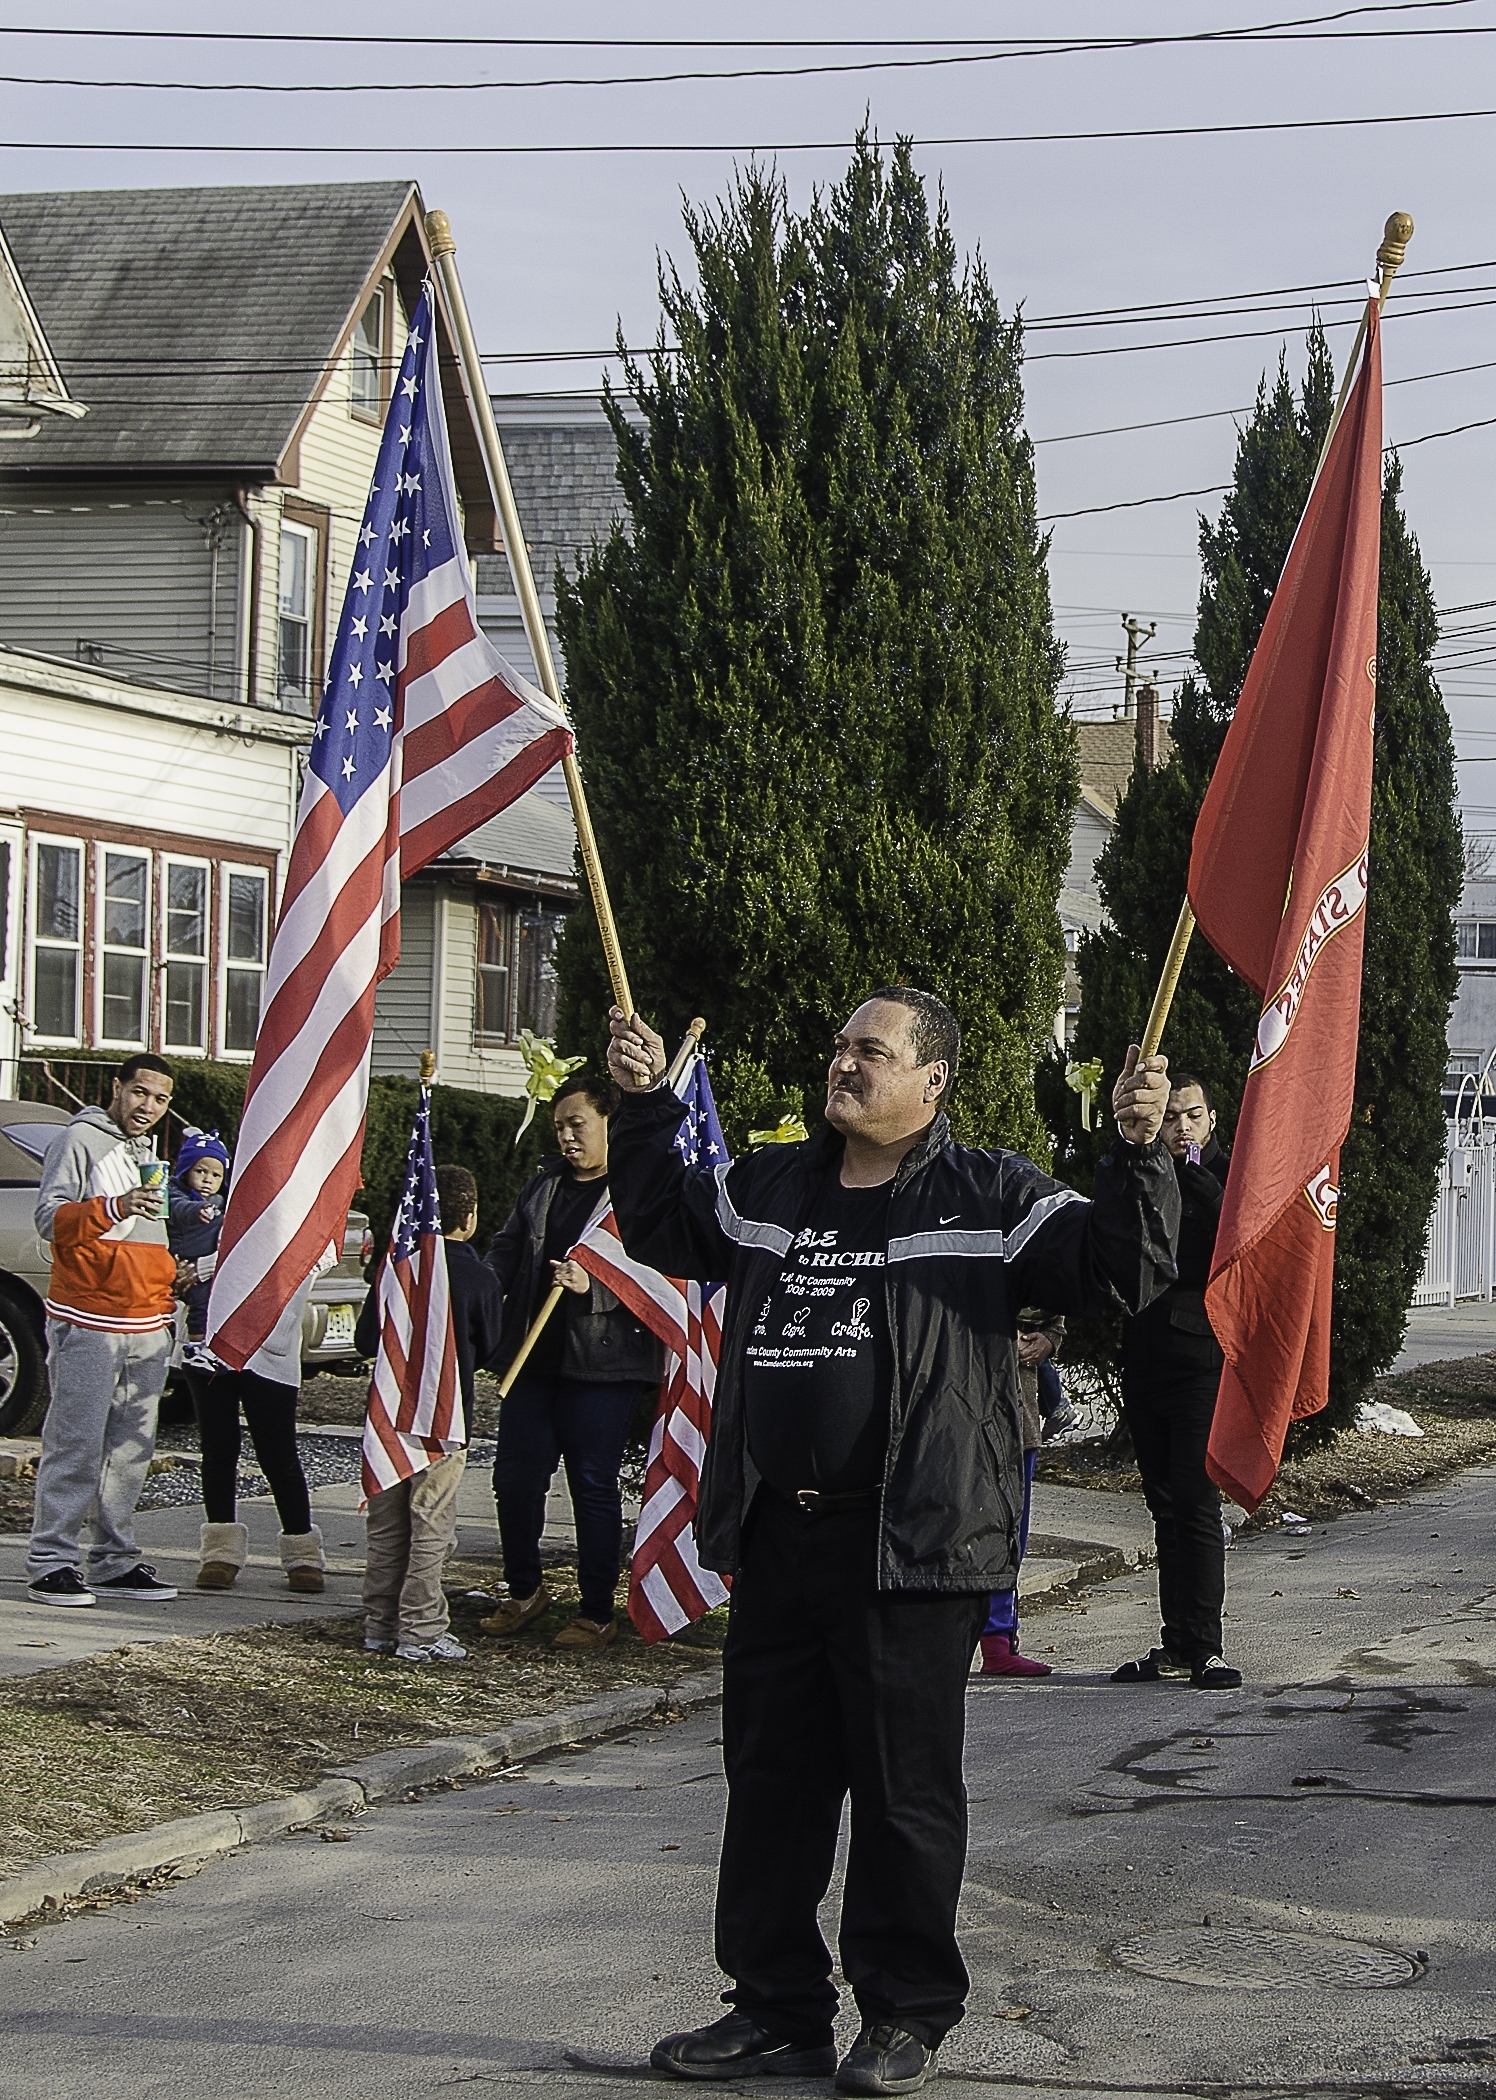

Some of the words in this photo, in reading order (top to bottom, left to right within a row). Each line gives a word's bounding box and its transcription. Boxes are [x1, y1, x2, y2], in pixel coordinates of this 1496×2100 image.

[798, 1254, 810, 1265] to
[810, 1252, 886, 1267] RICHE
[806, 1276, 856, 1286] Community
[810, 1286, 836, 1296] 2009
[758, 1346, 782, 1358] County
[782, 1346, 833, 1358] Community
[834, 1346, 857, 1357] Arts
